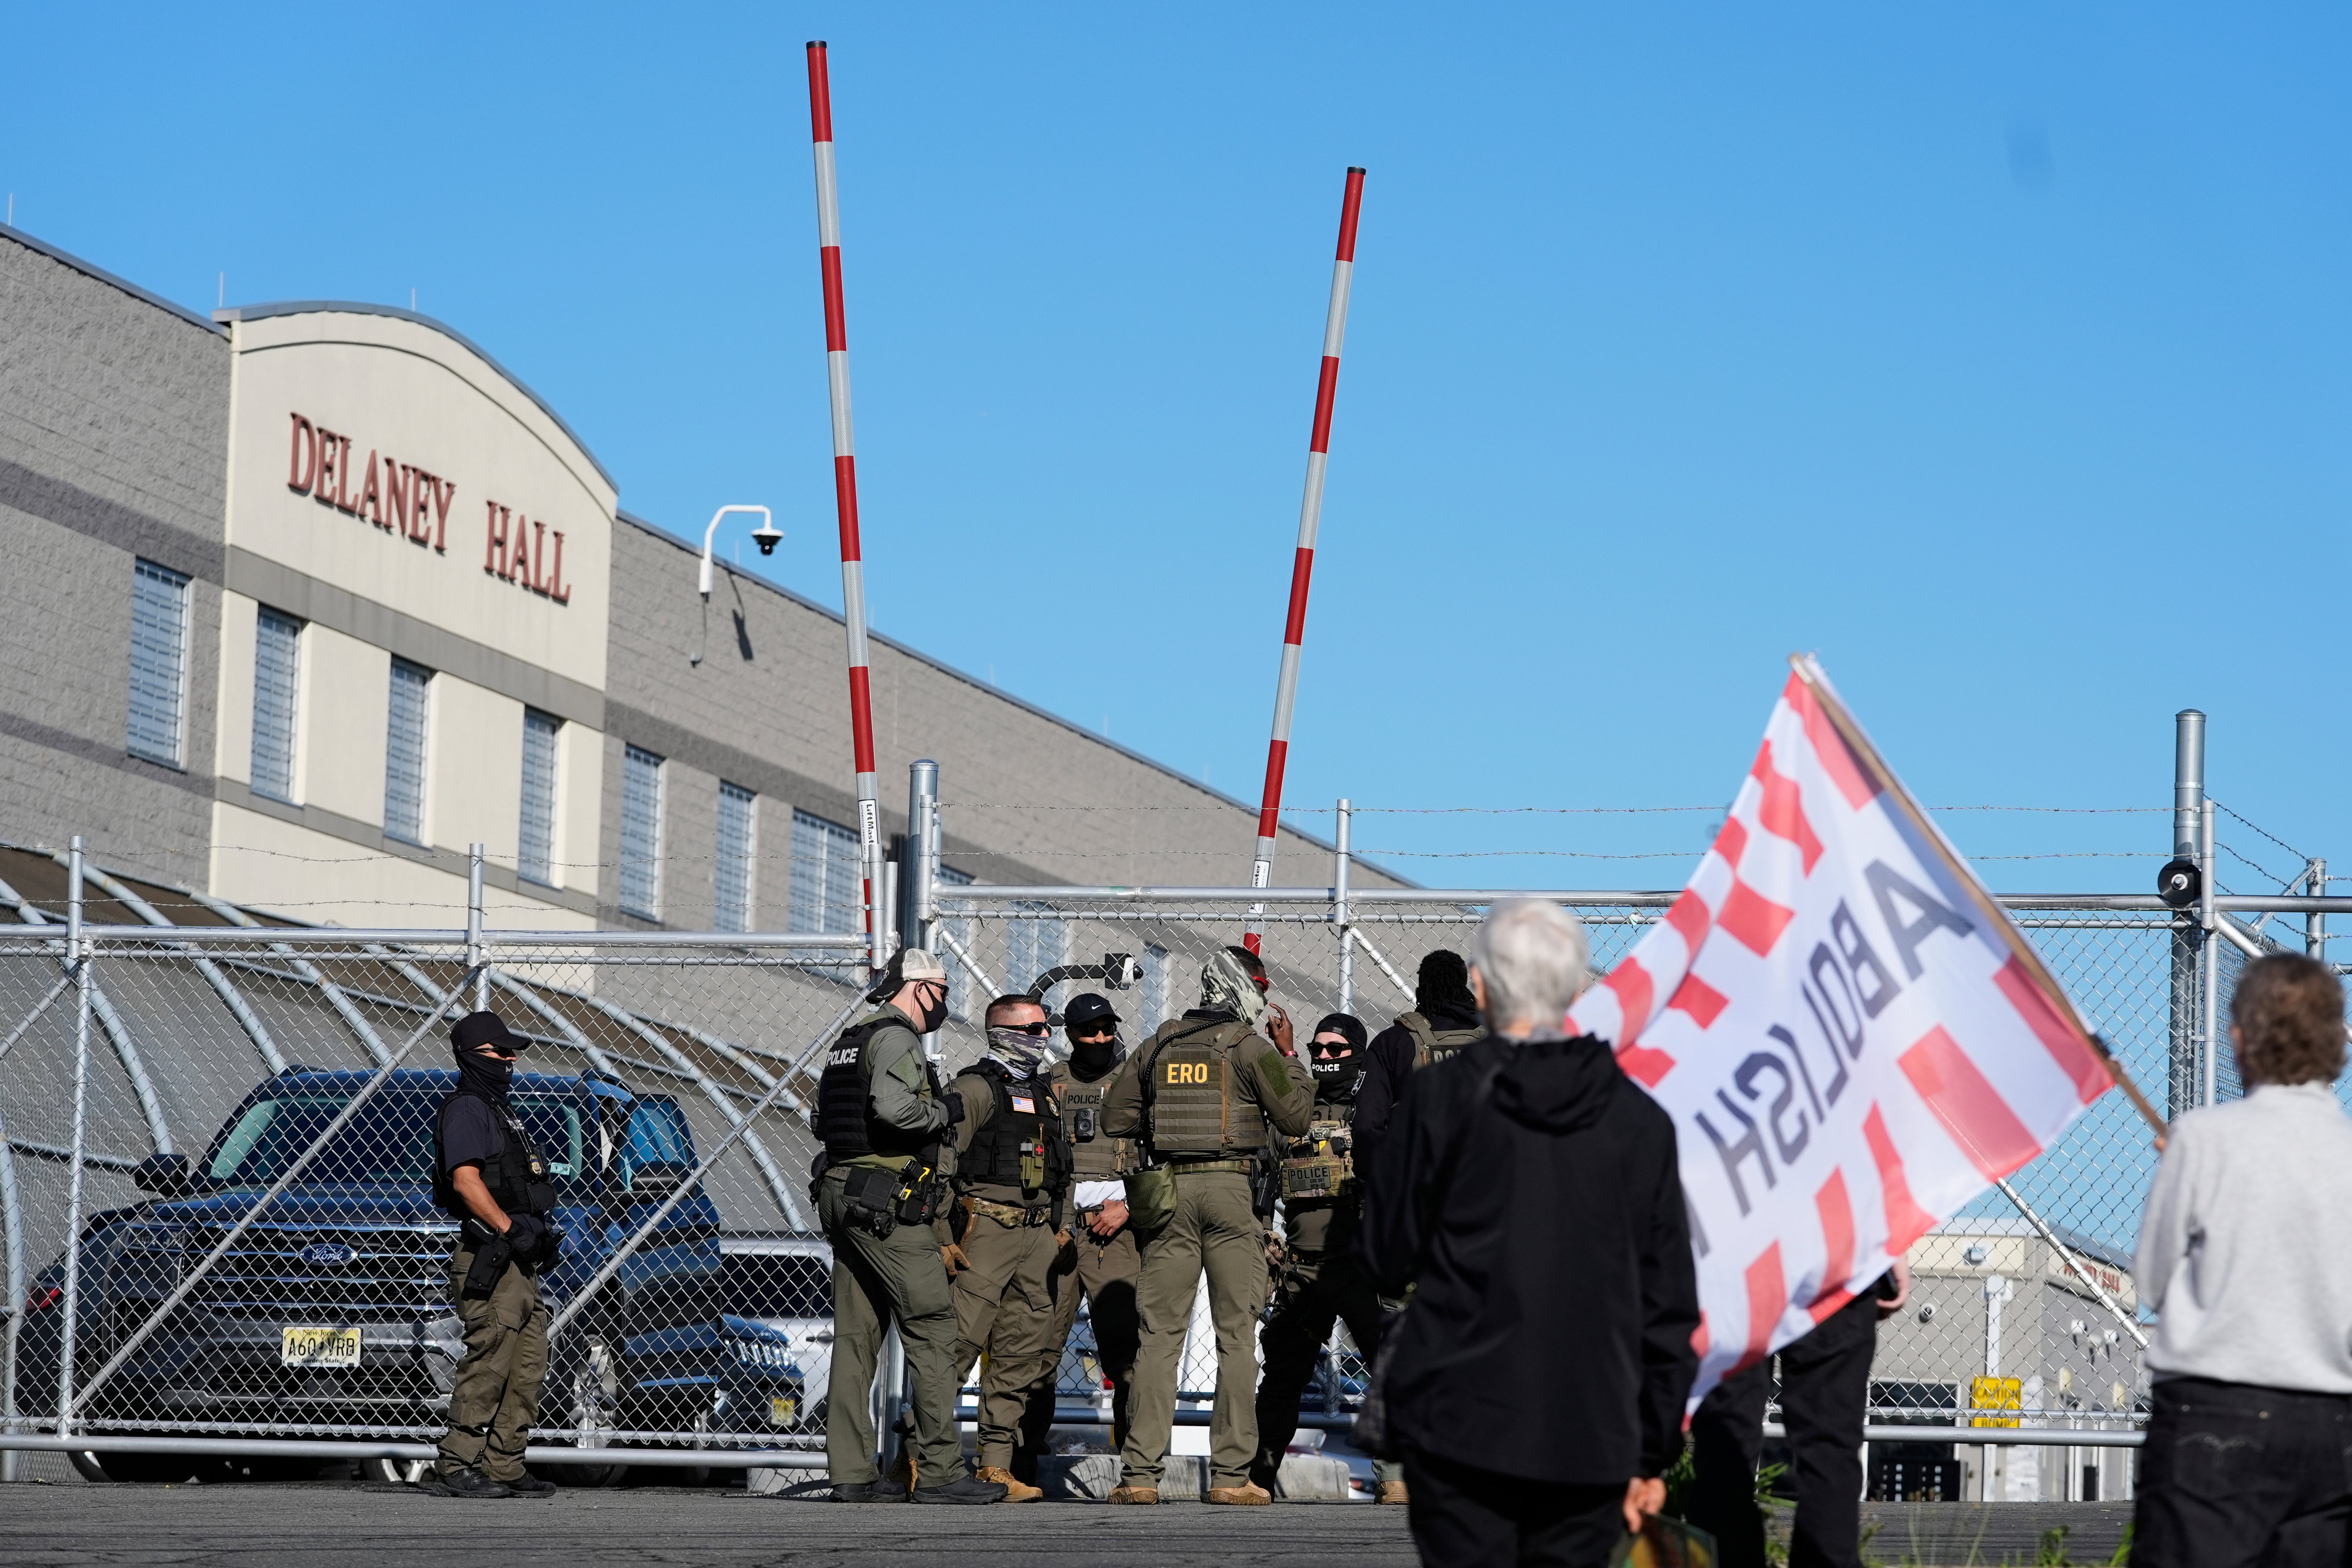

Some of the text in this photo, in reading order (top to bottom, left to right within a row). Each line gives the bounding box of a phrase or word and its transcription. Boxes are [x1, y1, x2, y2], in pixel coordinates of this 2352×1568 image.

[287, 412, 572, 604] DELANEY HALL
[866, 804, 875, 845] LiftMast
[826, 1048, 859, 1067] POLICE
[1167, 1063, 1208, 1083] ERO
[1312, 1063, 1340, 1072] POLICE
[1068, 1095, 1100, 1104] POLICE
[1290, 1167, 1329, 1181] POLICE
[312, 1247, 343, 1260] Ford
[288, 1337, 316, 1356] A60
